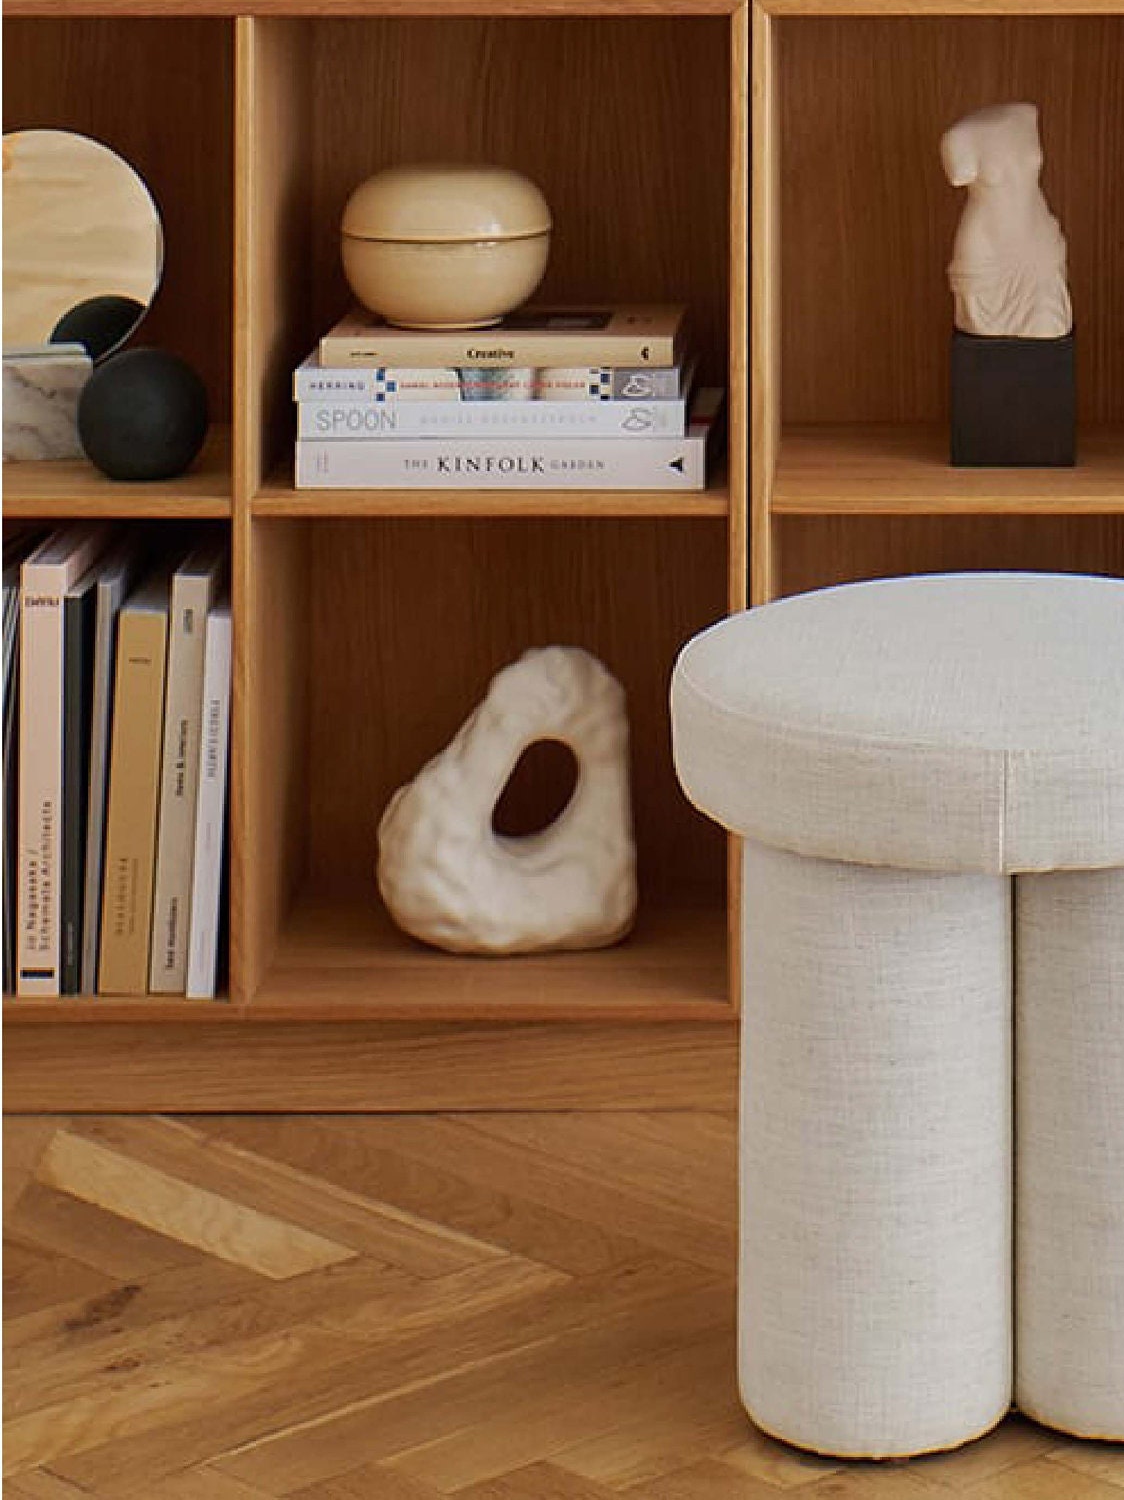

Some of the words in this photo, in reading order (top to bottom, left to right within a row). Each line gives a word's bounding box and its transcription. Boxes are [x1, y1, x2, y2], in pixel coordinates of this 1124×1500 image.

[466, 348, 514, 360] Creative
[315, 409, 397, 431] SPOON
[403, 458, 428, 470] THE
[437, 456, 545, 474] KINFOLK
